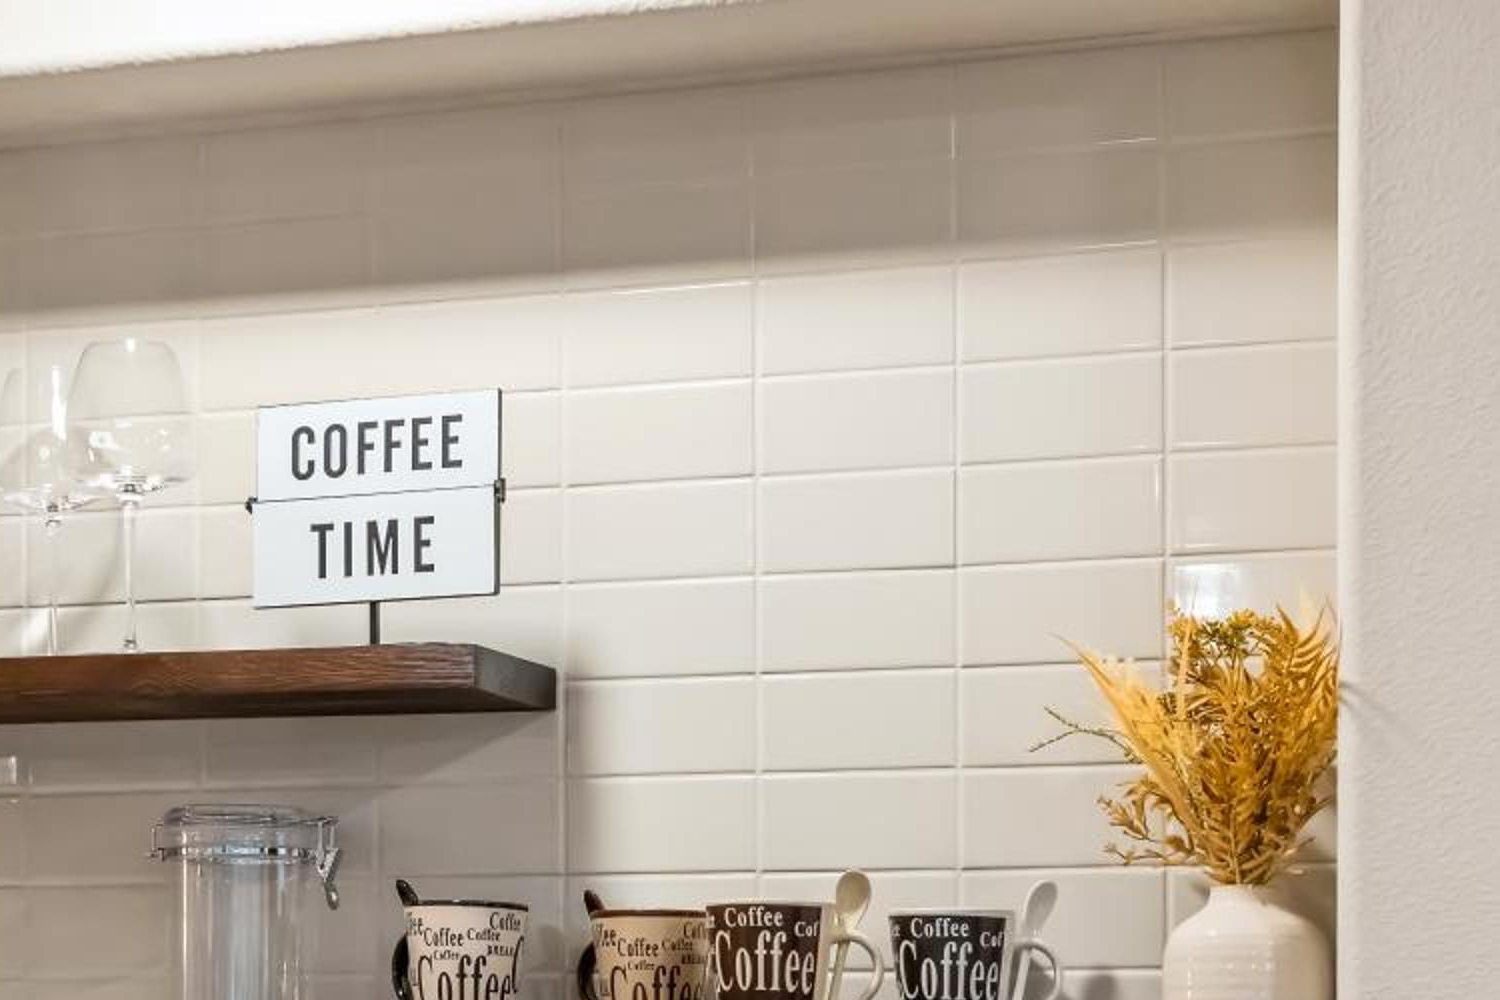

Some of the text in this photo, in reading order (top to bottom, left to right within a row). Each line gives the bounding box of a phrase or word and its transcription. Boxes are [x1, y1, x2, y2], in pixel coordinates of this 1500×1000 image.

[291, 413, 463, 480] COFFEE
[310, 515, 435, 578] TIME
[724, 906, 784, 928] Coffee
[910, 917, 970, 938] Coffee
[424, 927, 465, 947] Coffee
[617, 937, 659, 957] Coffee
[716, 929, 815, 995] Coffee
